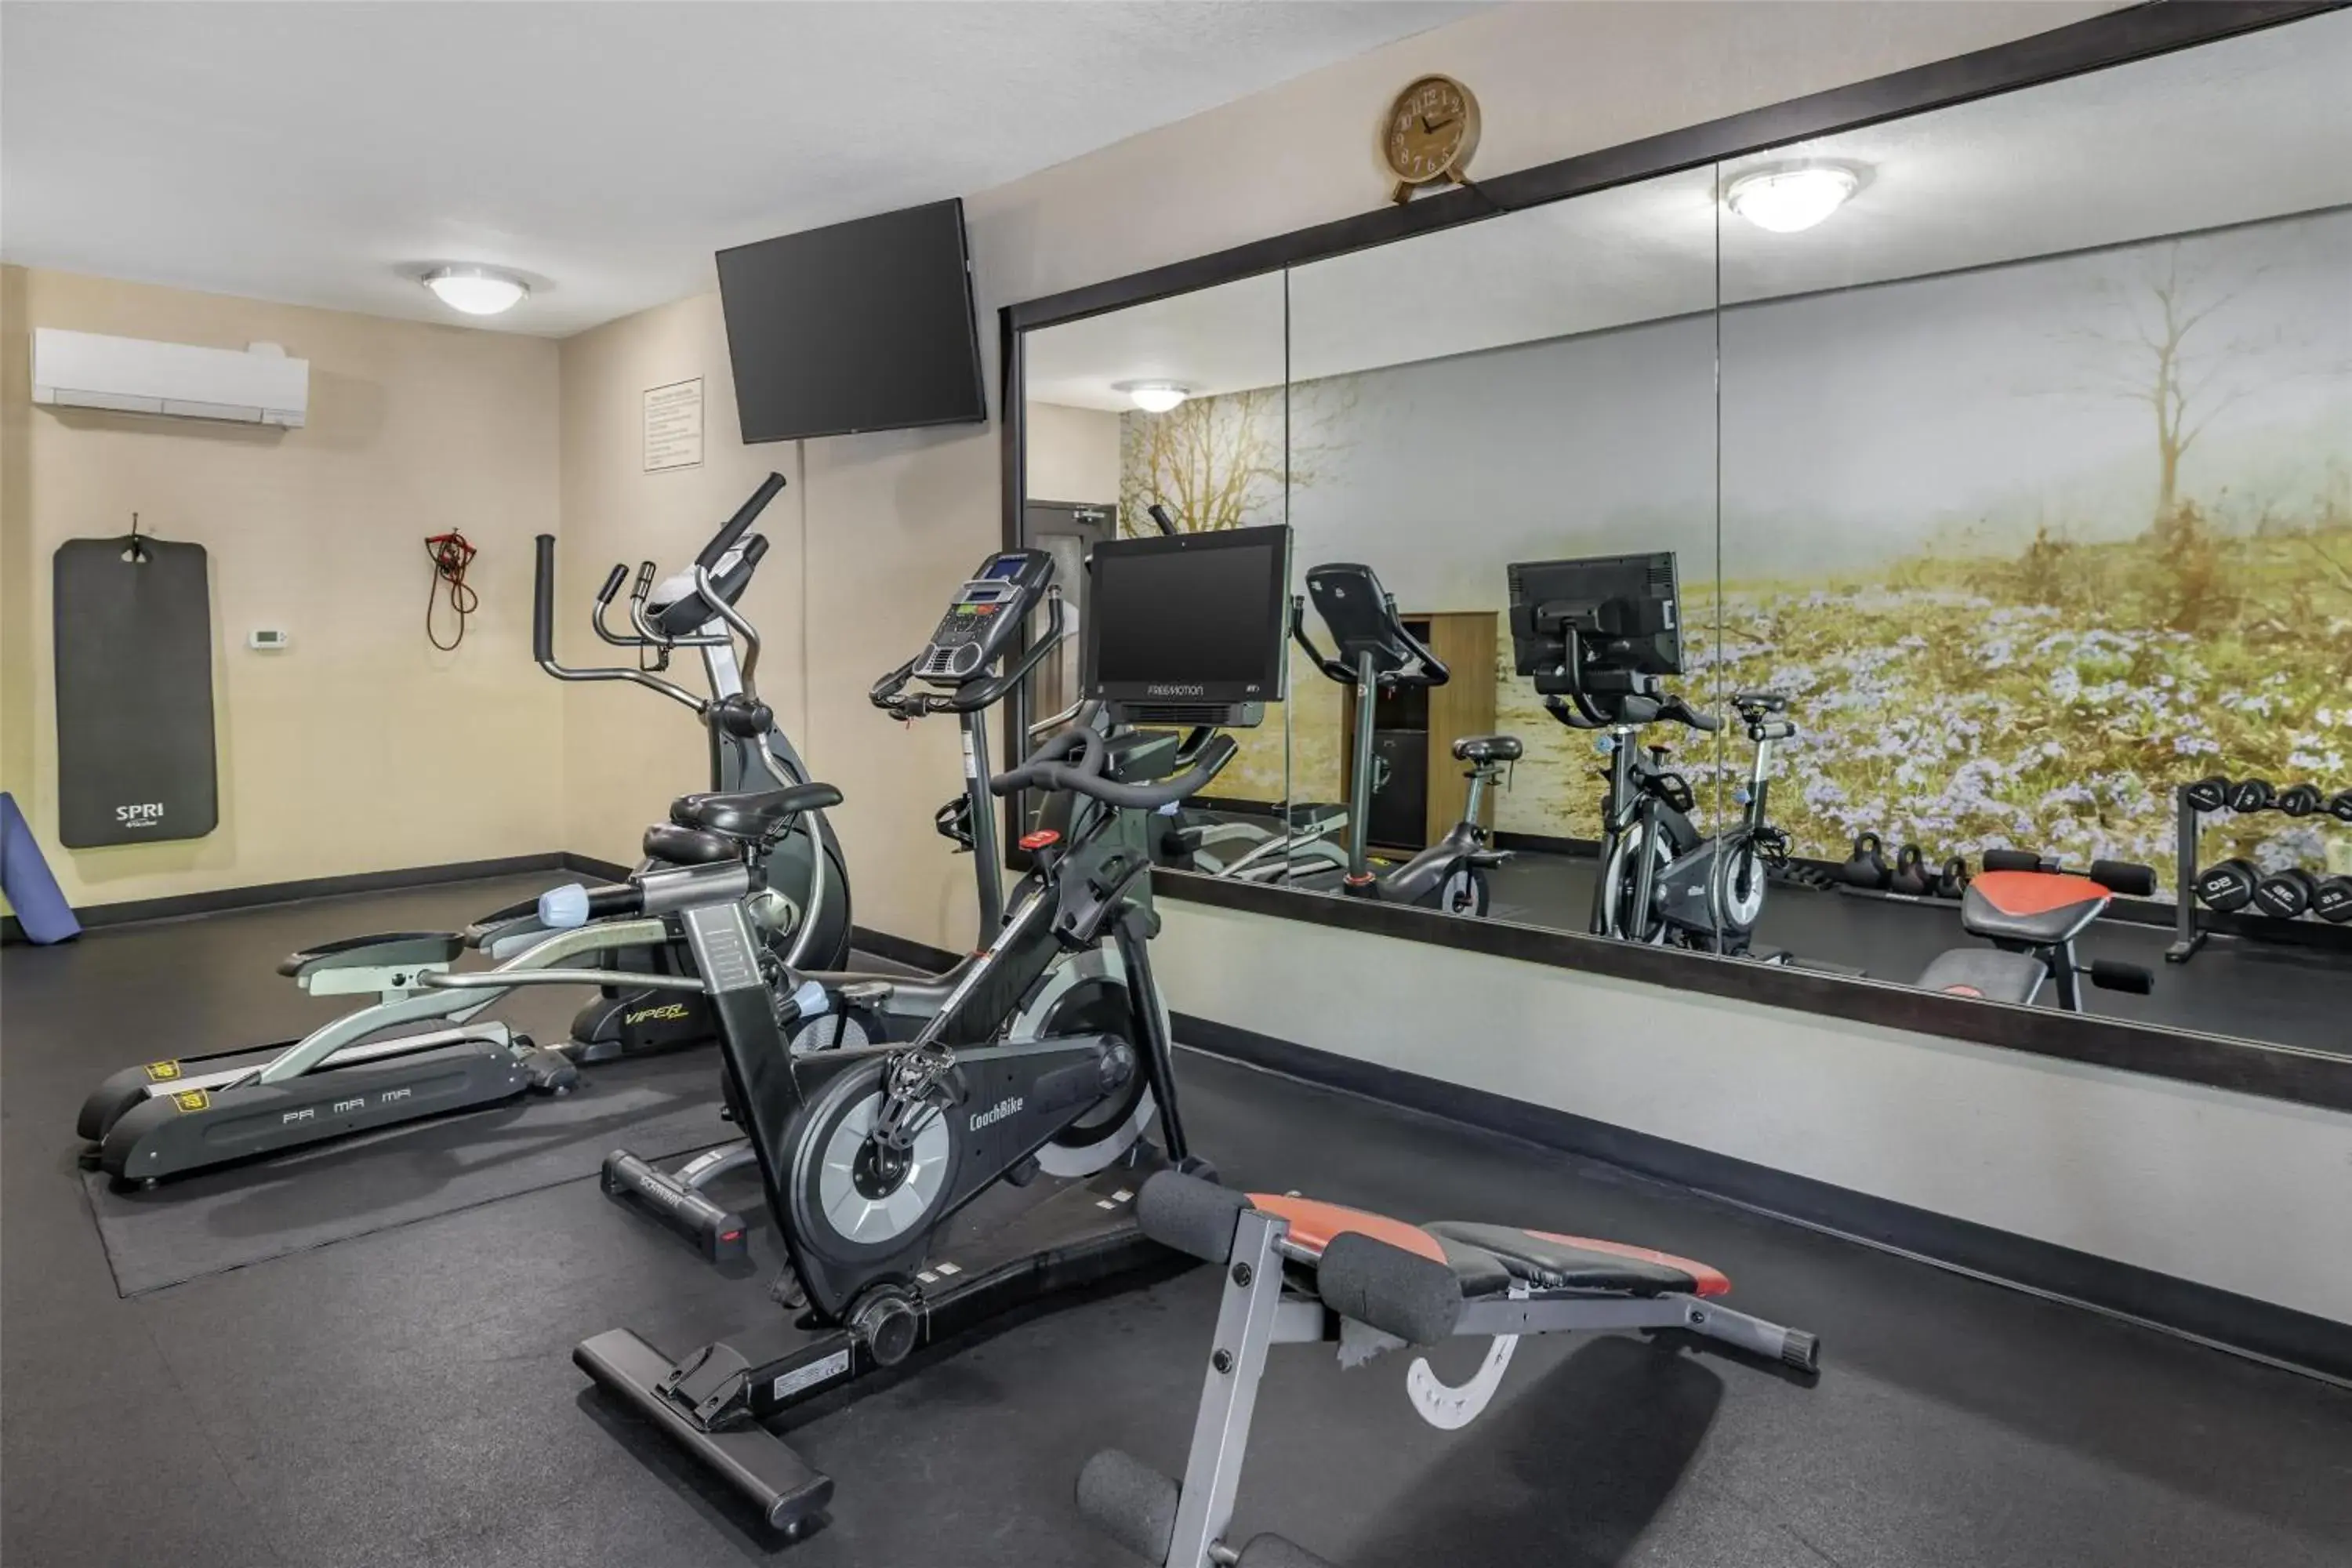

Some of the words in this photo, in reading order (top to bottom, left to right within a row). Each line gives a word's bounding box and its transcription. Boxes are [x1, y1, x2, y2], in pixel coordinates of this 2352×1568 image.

[1423, 89, 1437, 107] 12
[1442, 89, 1449, 106] 1
[1413, 154, 1422, 172] 7
[115, 802, 164, 821] SPRI
[625, 1003, 689, 1025] VIPER
[970, 1096, 1023, 1131] CoachBike
